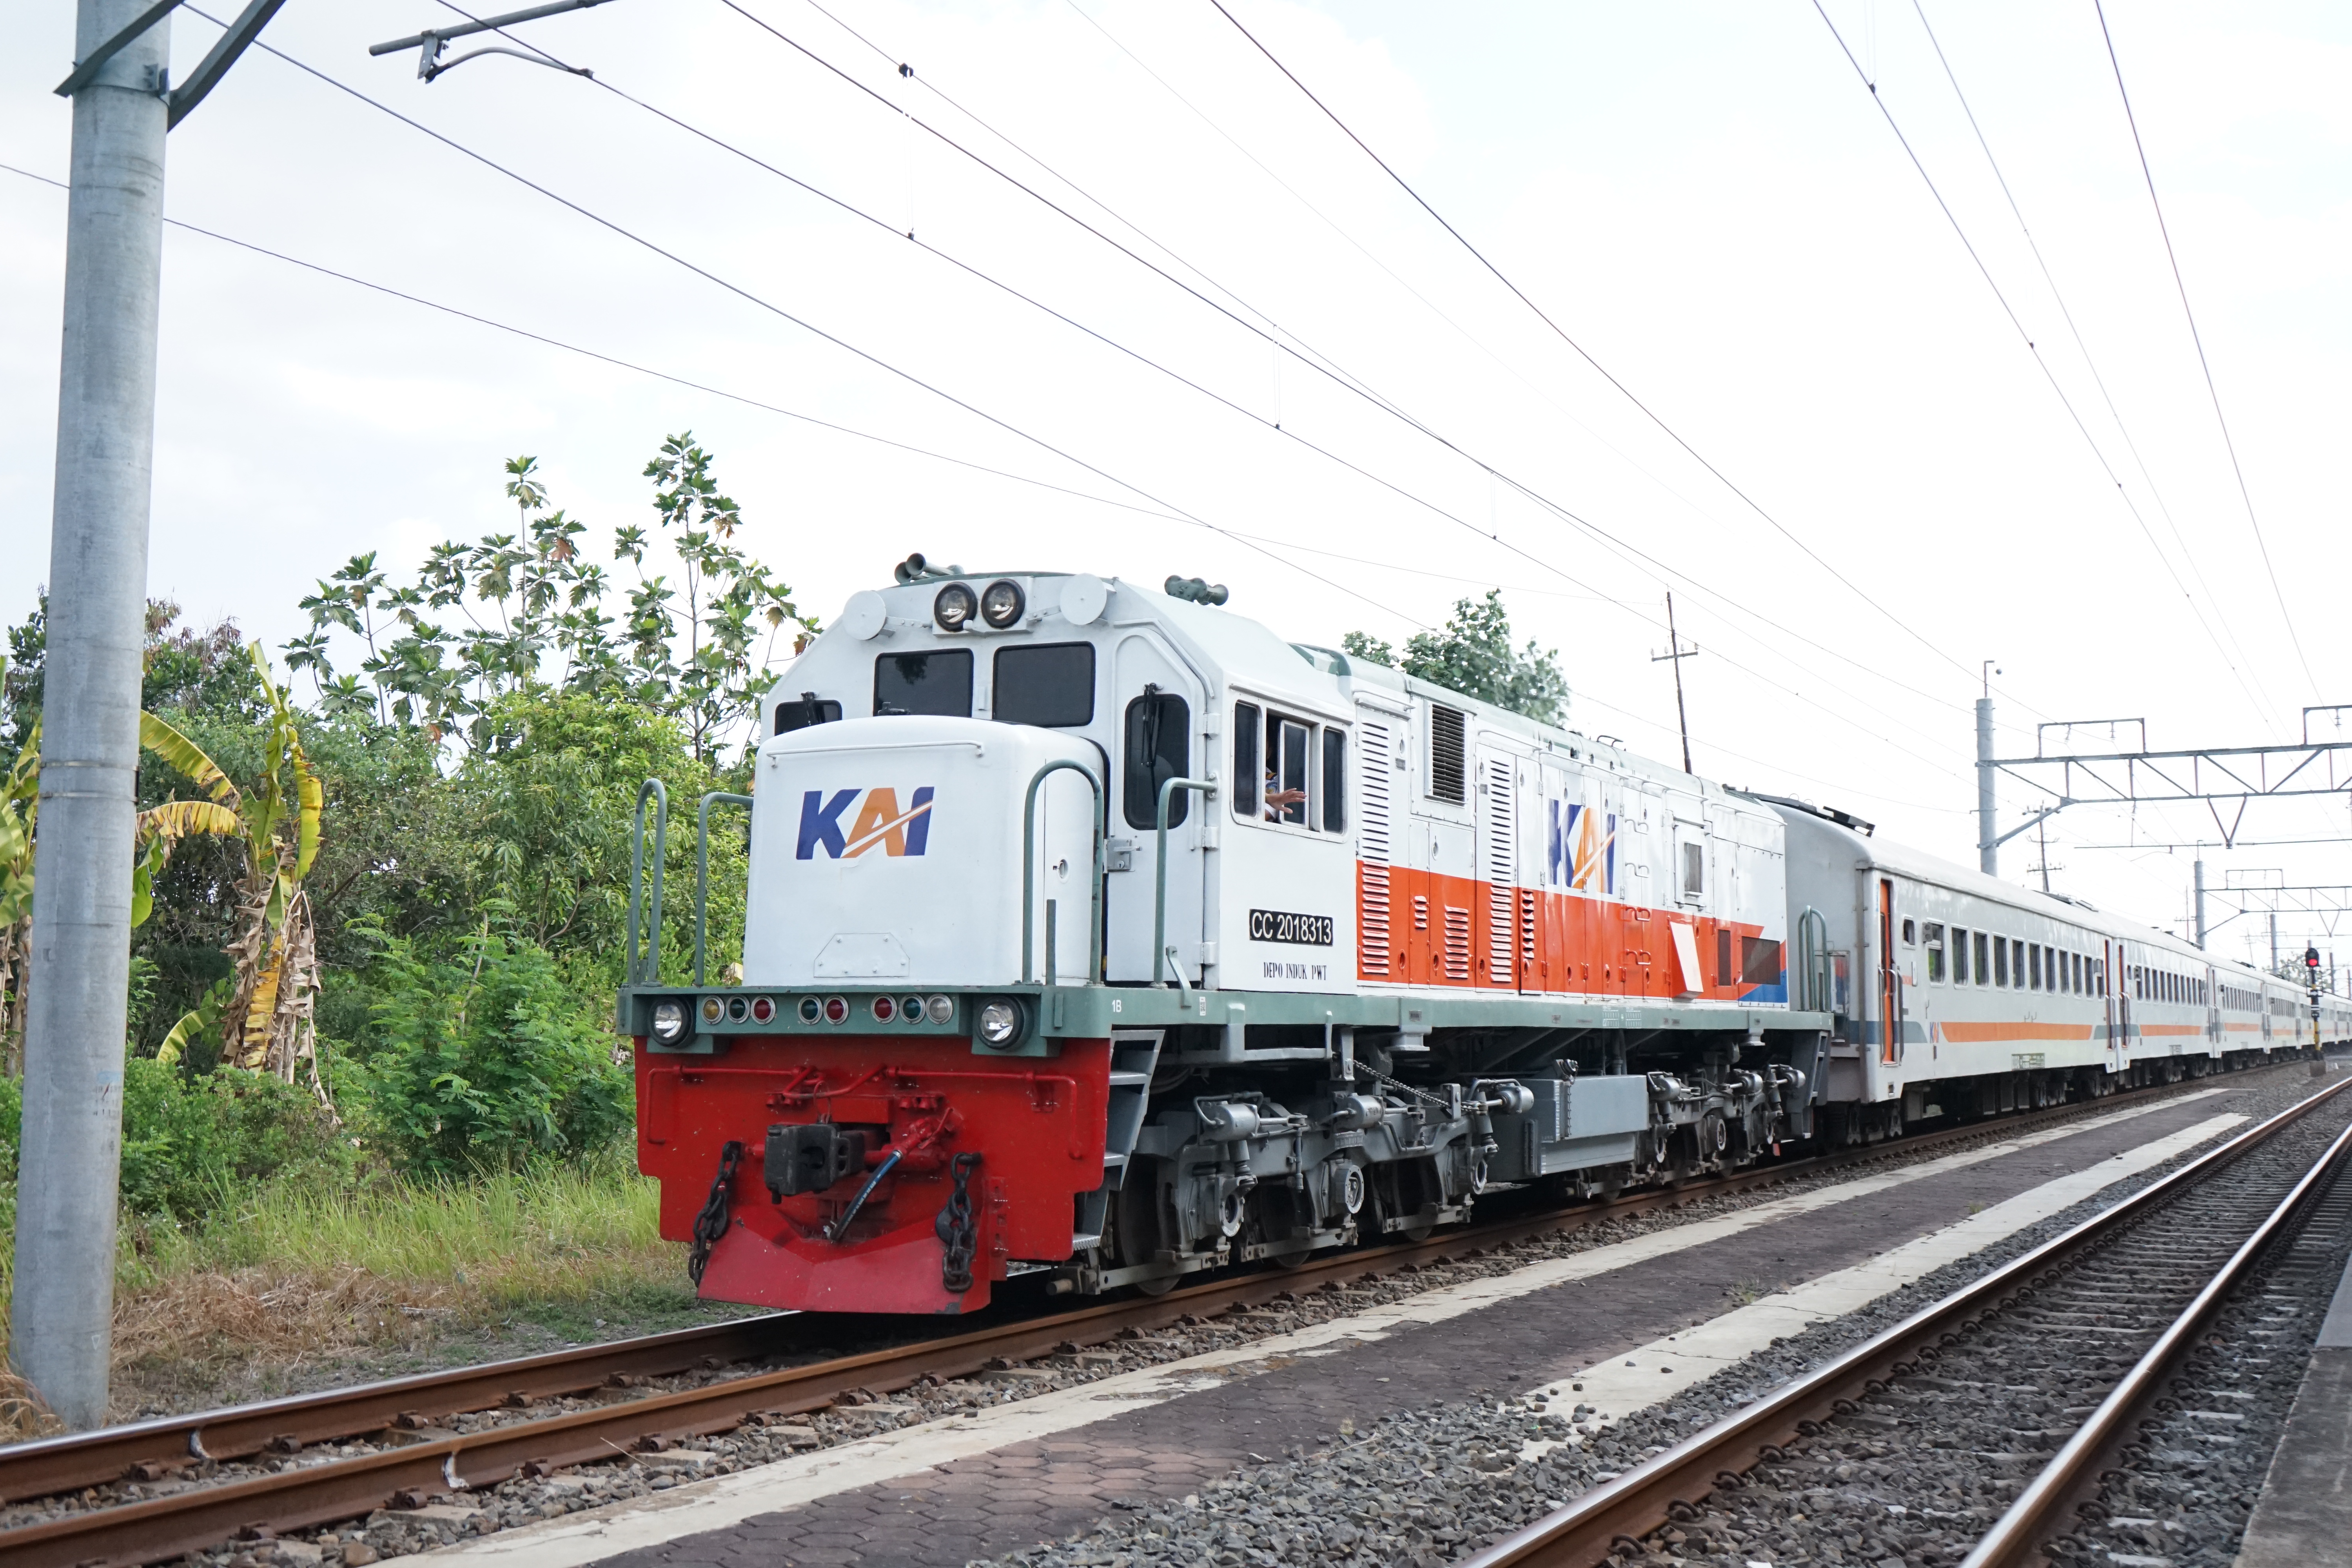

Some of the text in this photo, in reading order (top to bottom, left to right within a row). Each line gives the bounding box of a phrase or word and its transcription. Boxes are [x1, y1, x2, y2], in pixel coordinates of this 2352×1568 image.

[796, 786, 935, 860] KAI
[1548, 798, 1615, 895] KAI
[1252, 912, 1332, 944] CC 2018313
[1264, 962, 1327, 981] DEPO INDUK PWT
[1112, 1000, 1122, 1013] 1B
